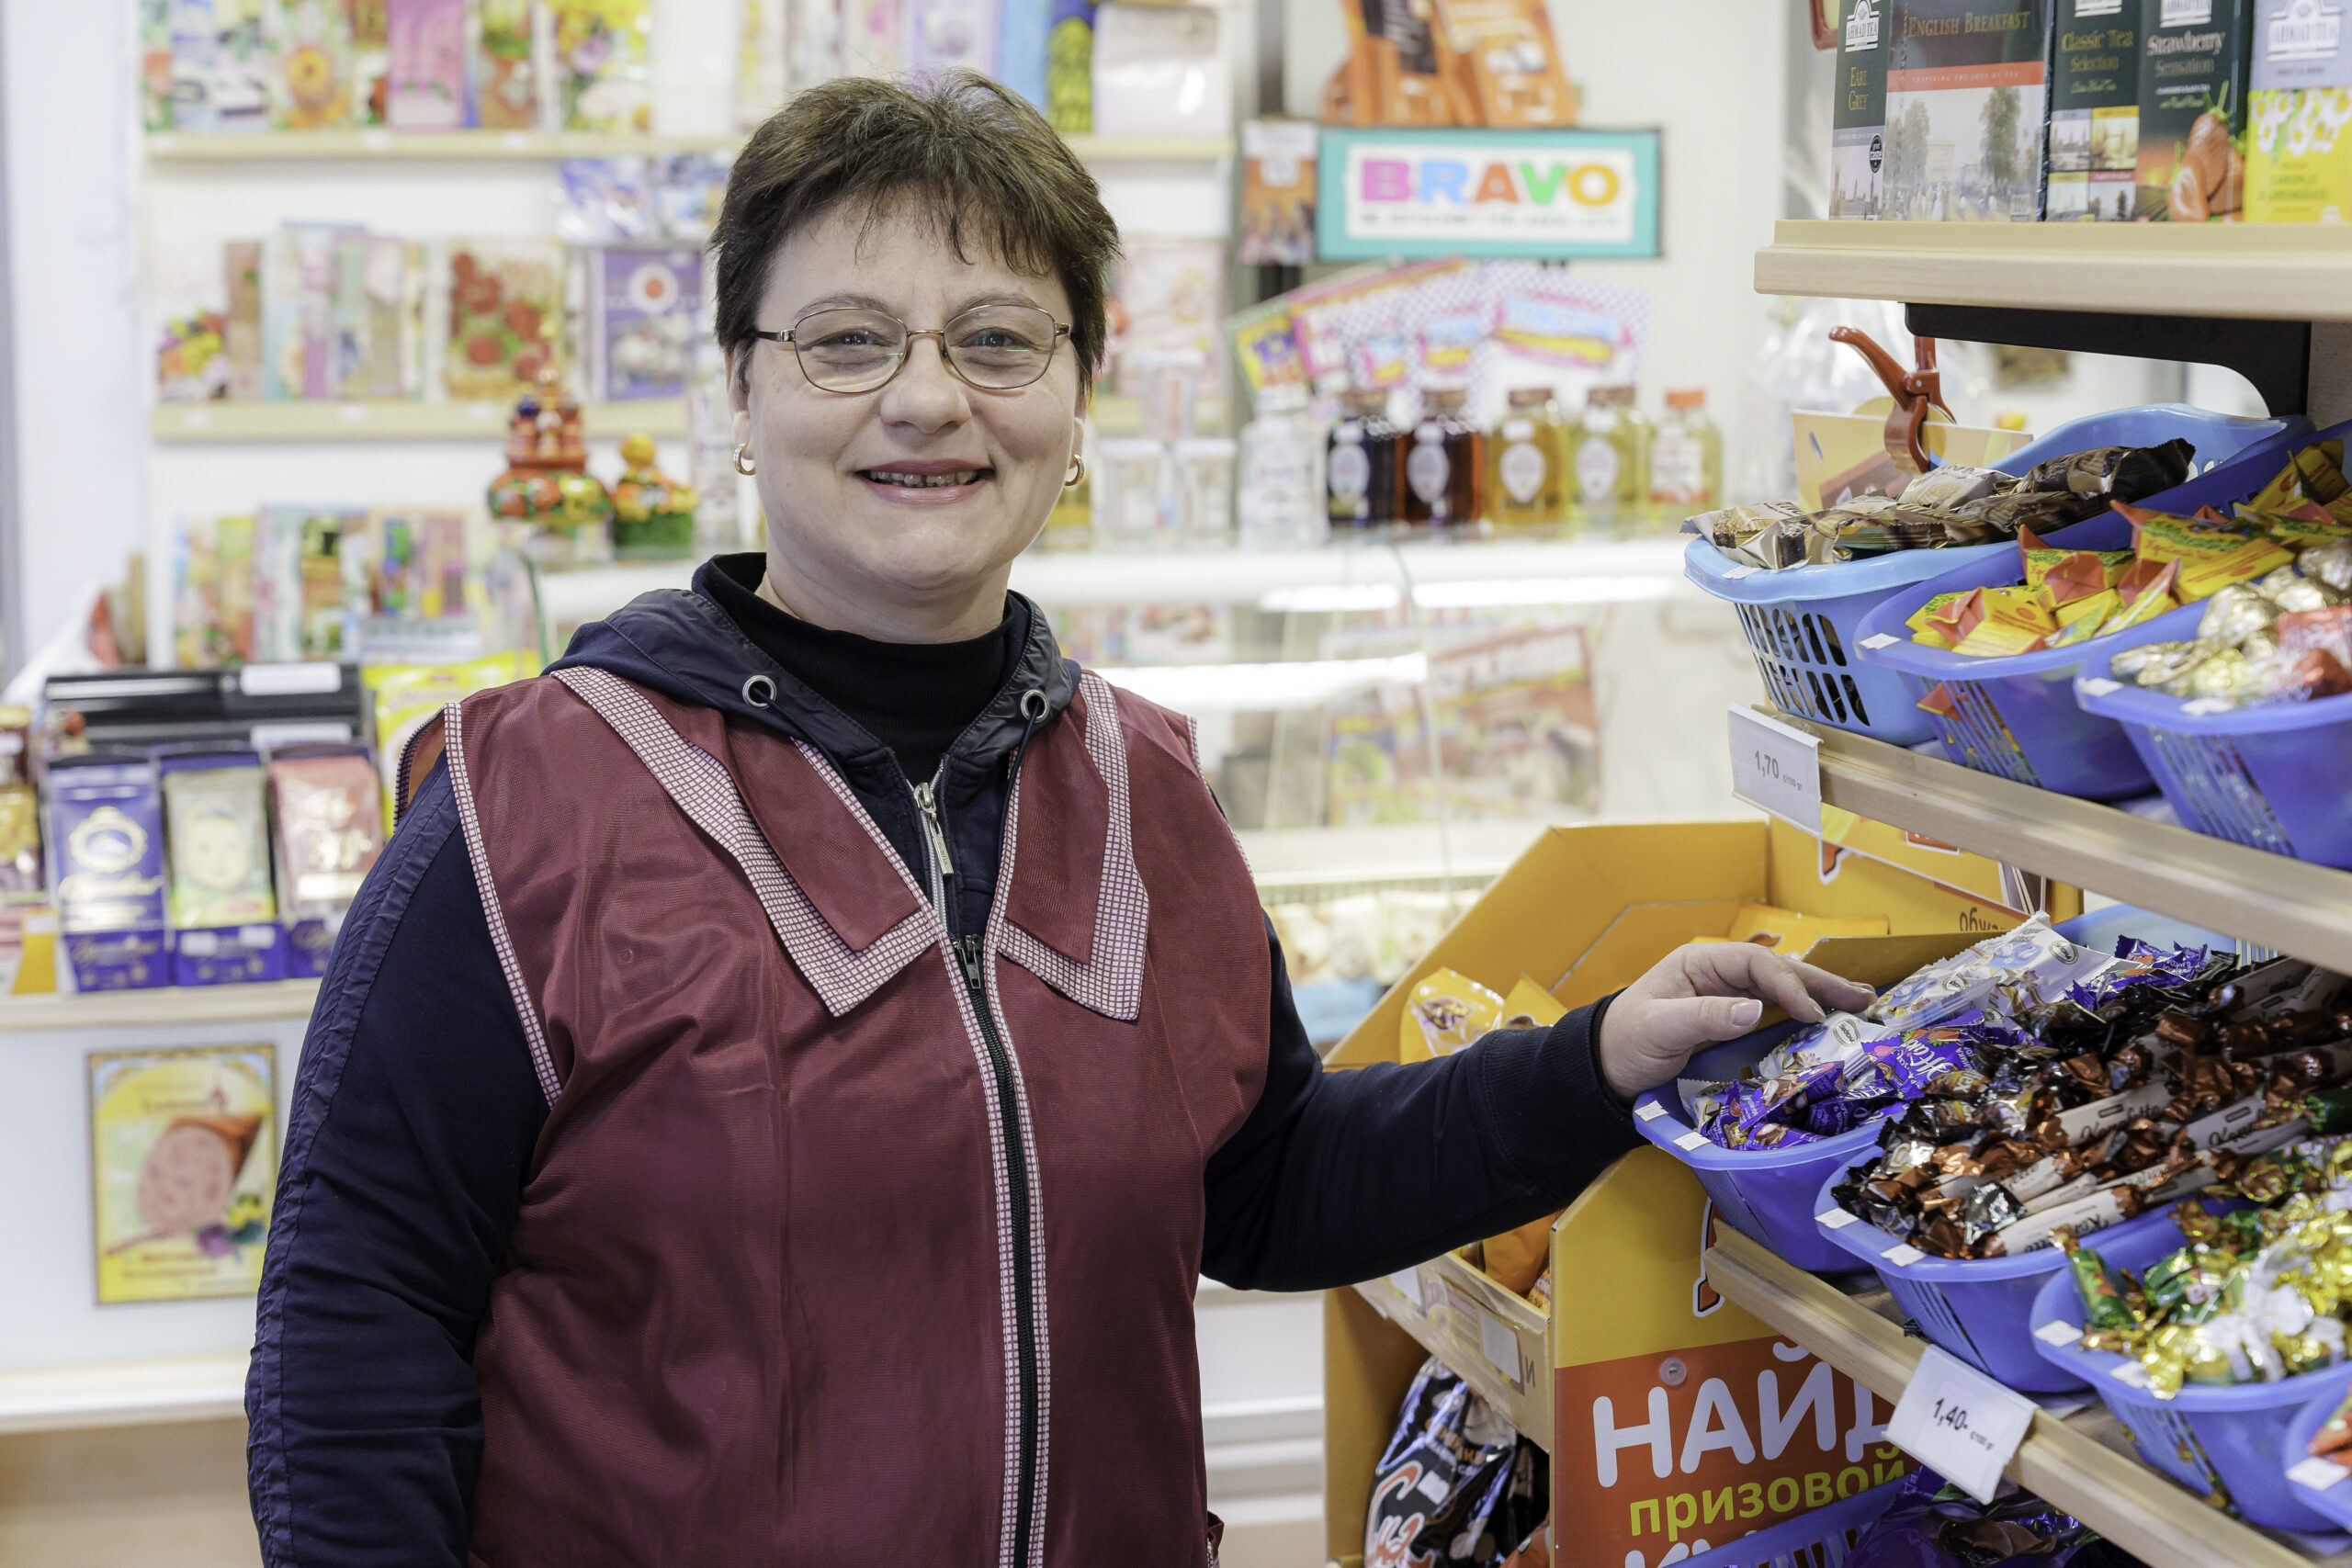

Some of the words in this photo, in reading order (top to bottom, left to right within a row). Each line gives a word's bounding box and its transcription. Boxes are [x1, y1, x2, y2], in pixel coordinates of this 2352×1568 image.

[1908, 16, 1960, 38] ENGLISH
[1964, 11, 2030, 33] BREAKFAST
[2061, 30, 2105, 51] Classic
[2107, 29, 2134, 48] Tea
[2146, 30, 2226, 56] Strawberry
[1849, 66, 1869, 87] EARL
[1848, 90, 1869, 110] GREY
[1361, 159, 1621, 207] BRAVO
[1755, 750, 1780, 779] 1,70
[1630, 1446, 1905, 1542] призовой
